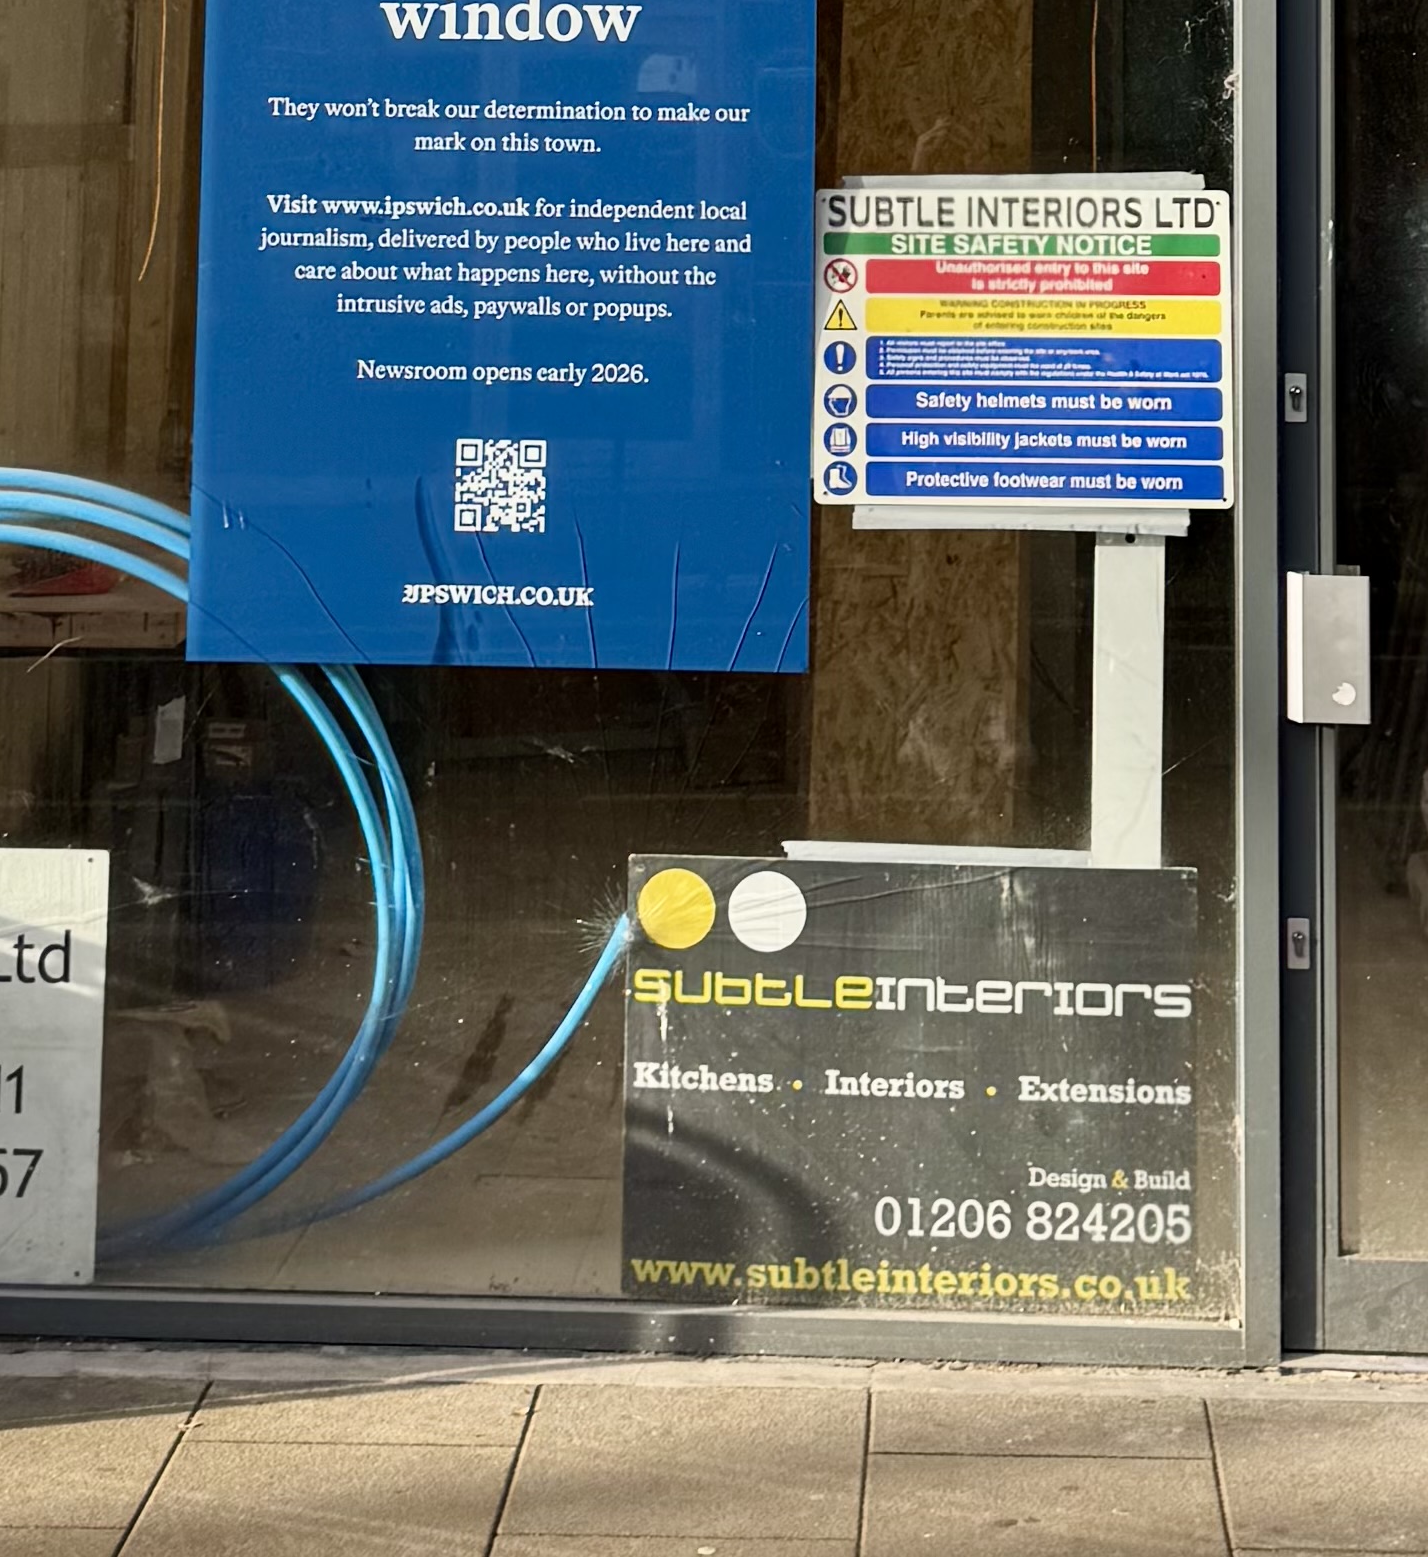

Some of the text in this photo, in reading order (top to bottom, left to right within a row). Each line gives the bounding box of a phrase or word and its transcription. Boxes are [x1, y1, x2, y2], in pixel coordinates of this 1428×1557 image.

[268, 97, 319, 120] They
[385, 99, 439, 117] break
[445, 105, 480, 118] our
[484, 100, 625, 120] determination
[632, 106, 652, 120] to
[658, 103, 710, 121] make
[715, 108, 750, 122] our
[415, 132, 601, 152] mark on this town.
[267, 194, 746, 222] Visit www.ipswich.co.uk for independent local
[827, 196, 1214, 228] SUBTLE INTERIORS LTD
[258, 227, 751, 254] journalism, delivered by people who live here and
[892, 235, 1152, 255] SITE SAFETY NOTICE
[295, 261, 716, 287] care about what happens here, without the
[936, 262, 1149, 277] Unauthorised entry to this site
[972, 279, 1113, 293] is strictly prohibited
[337, 294, 672, 321] intrusive ads, paywalls or popups.
[1128, 313, 1166, 322] dangers
[1028, 321, 1087, 331] construction
[357, 360, 648, 386] Newsroom opens early 2026.
[916, 392, 1172, 412] Safety helmets must be worn
[902, 431, 1187, 449] High visibility jackets must be worn
[906, 471, 1183, 490] Protective footwear must be worn
[633, 1062, 1192, 1106] Kitchens Interiors Extensions
[1028, 1168, 1190, 1192] Design & Build
[874, 1197, 1192, 1244] 01206 824205
[630, 1257, 1190, 1302] www.subtleinteriors.co.uk
